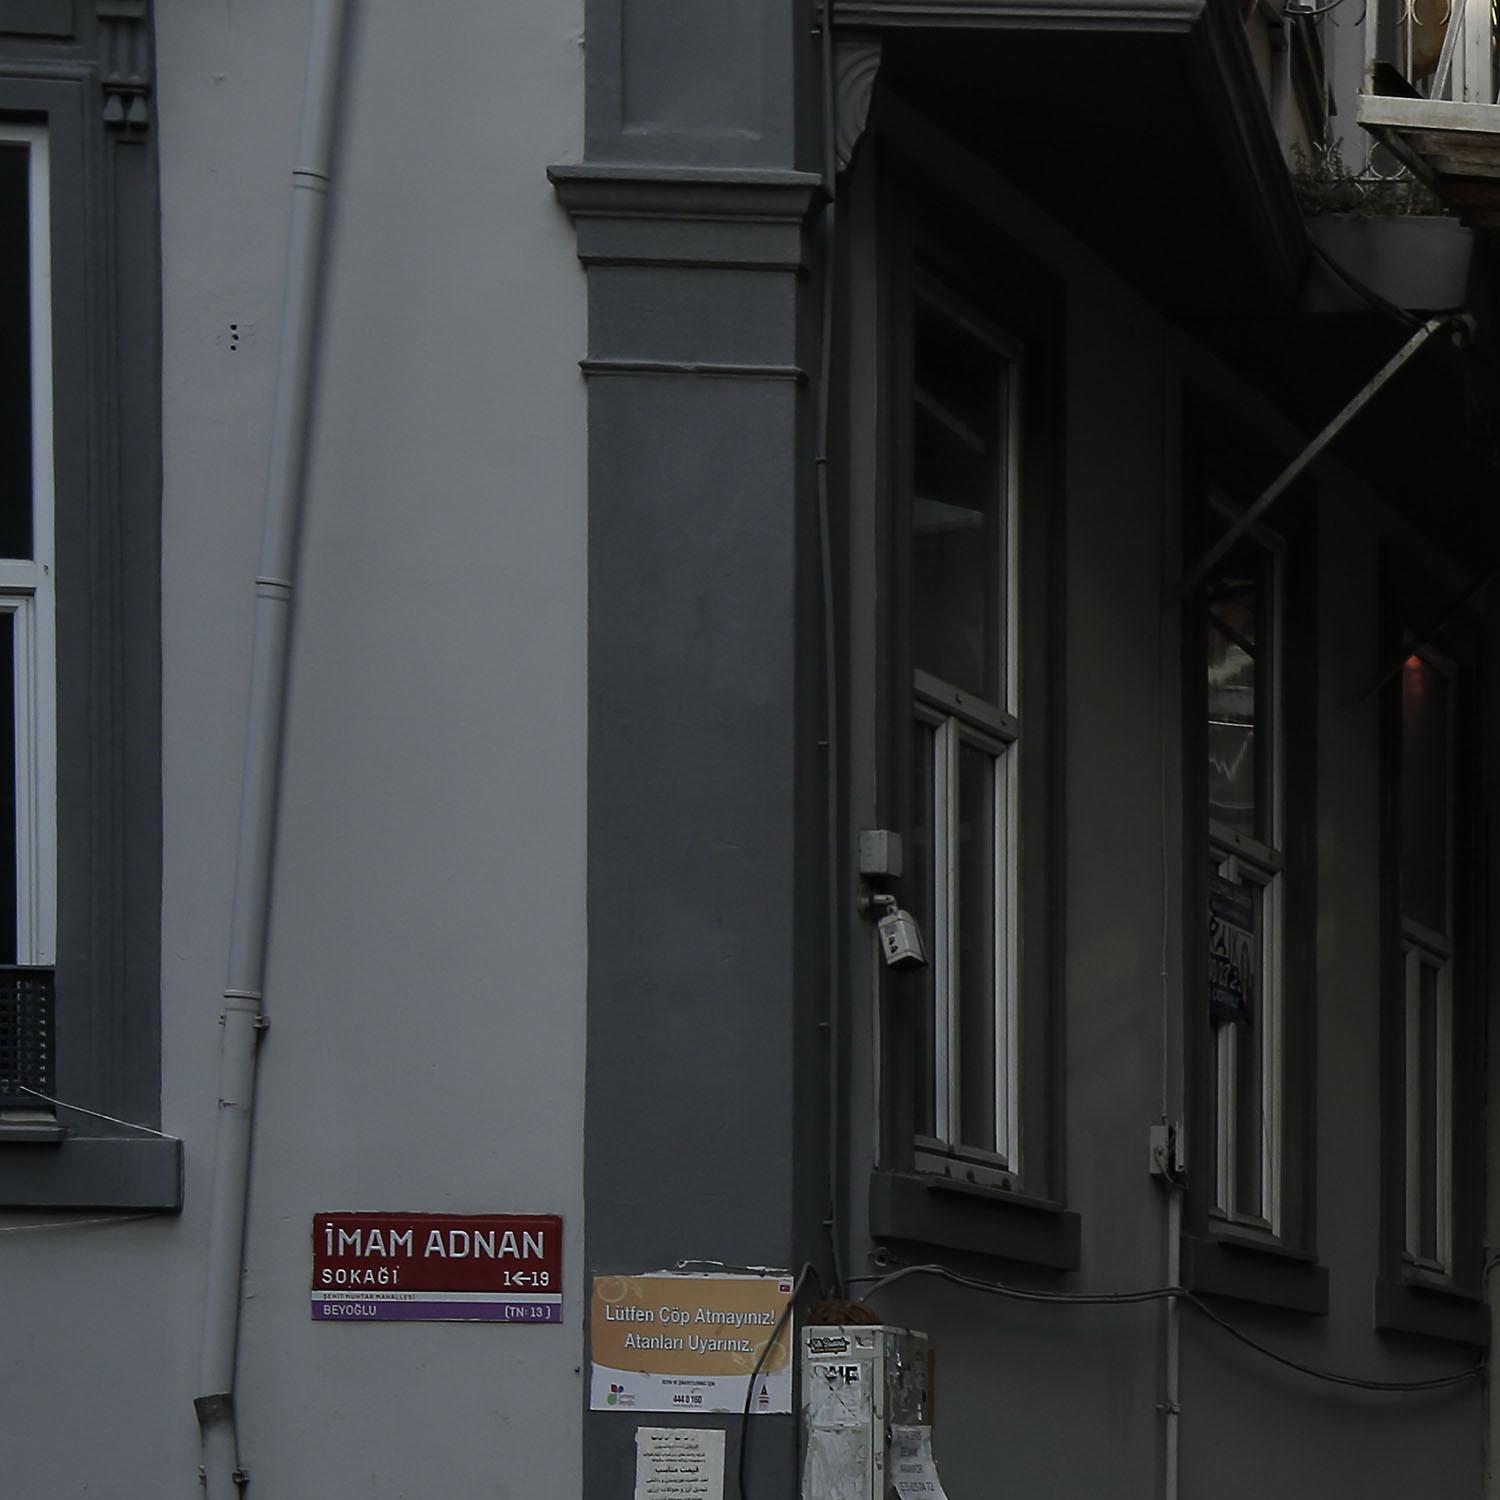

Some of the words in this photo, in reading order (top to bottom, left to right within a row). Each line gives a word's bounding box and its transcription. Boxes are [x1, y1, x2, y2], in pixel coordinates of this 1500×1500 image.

[324, 1222, 414, 1257] İMAM
[423, 1230, 545, 1260] ADNAN
[323, 1303, 377, 1316] BEYOĞLU
[605, 1304, 655, 1323] Lütfen
[659, 1306, 690, 1326] Çöp
[694, 1308, 776, 1329] Atmayınız!
[624, 1333, 684, 1350] Atanları
[687, 1335, 755, 1354] Uyarınız.
